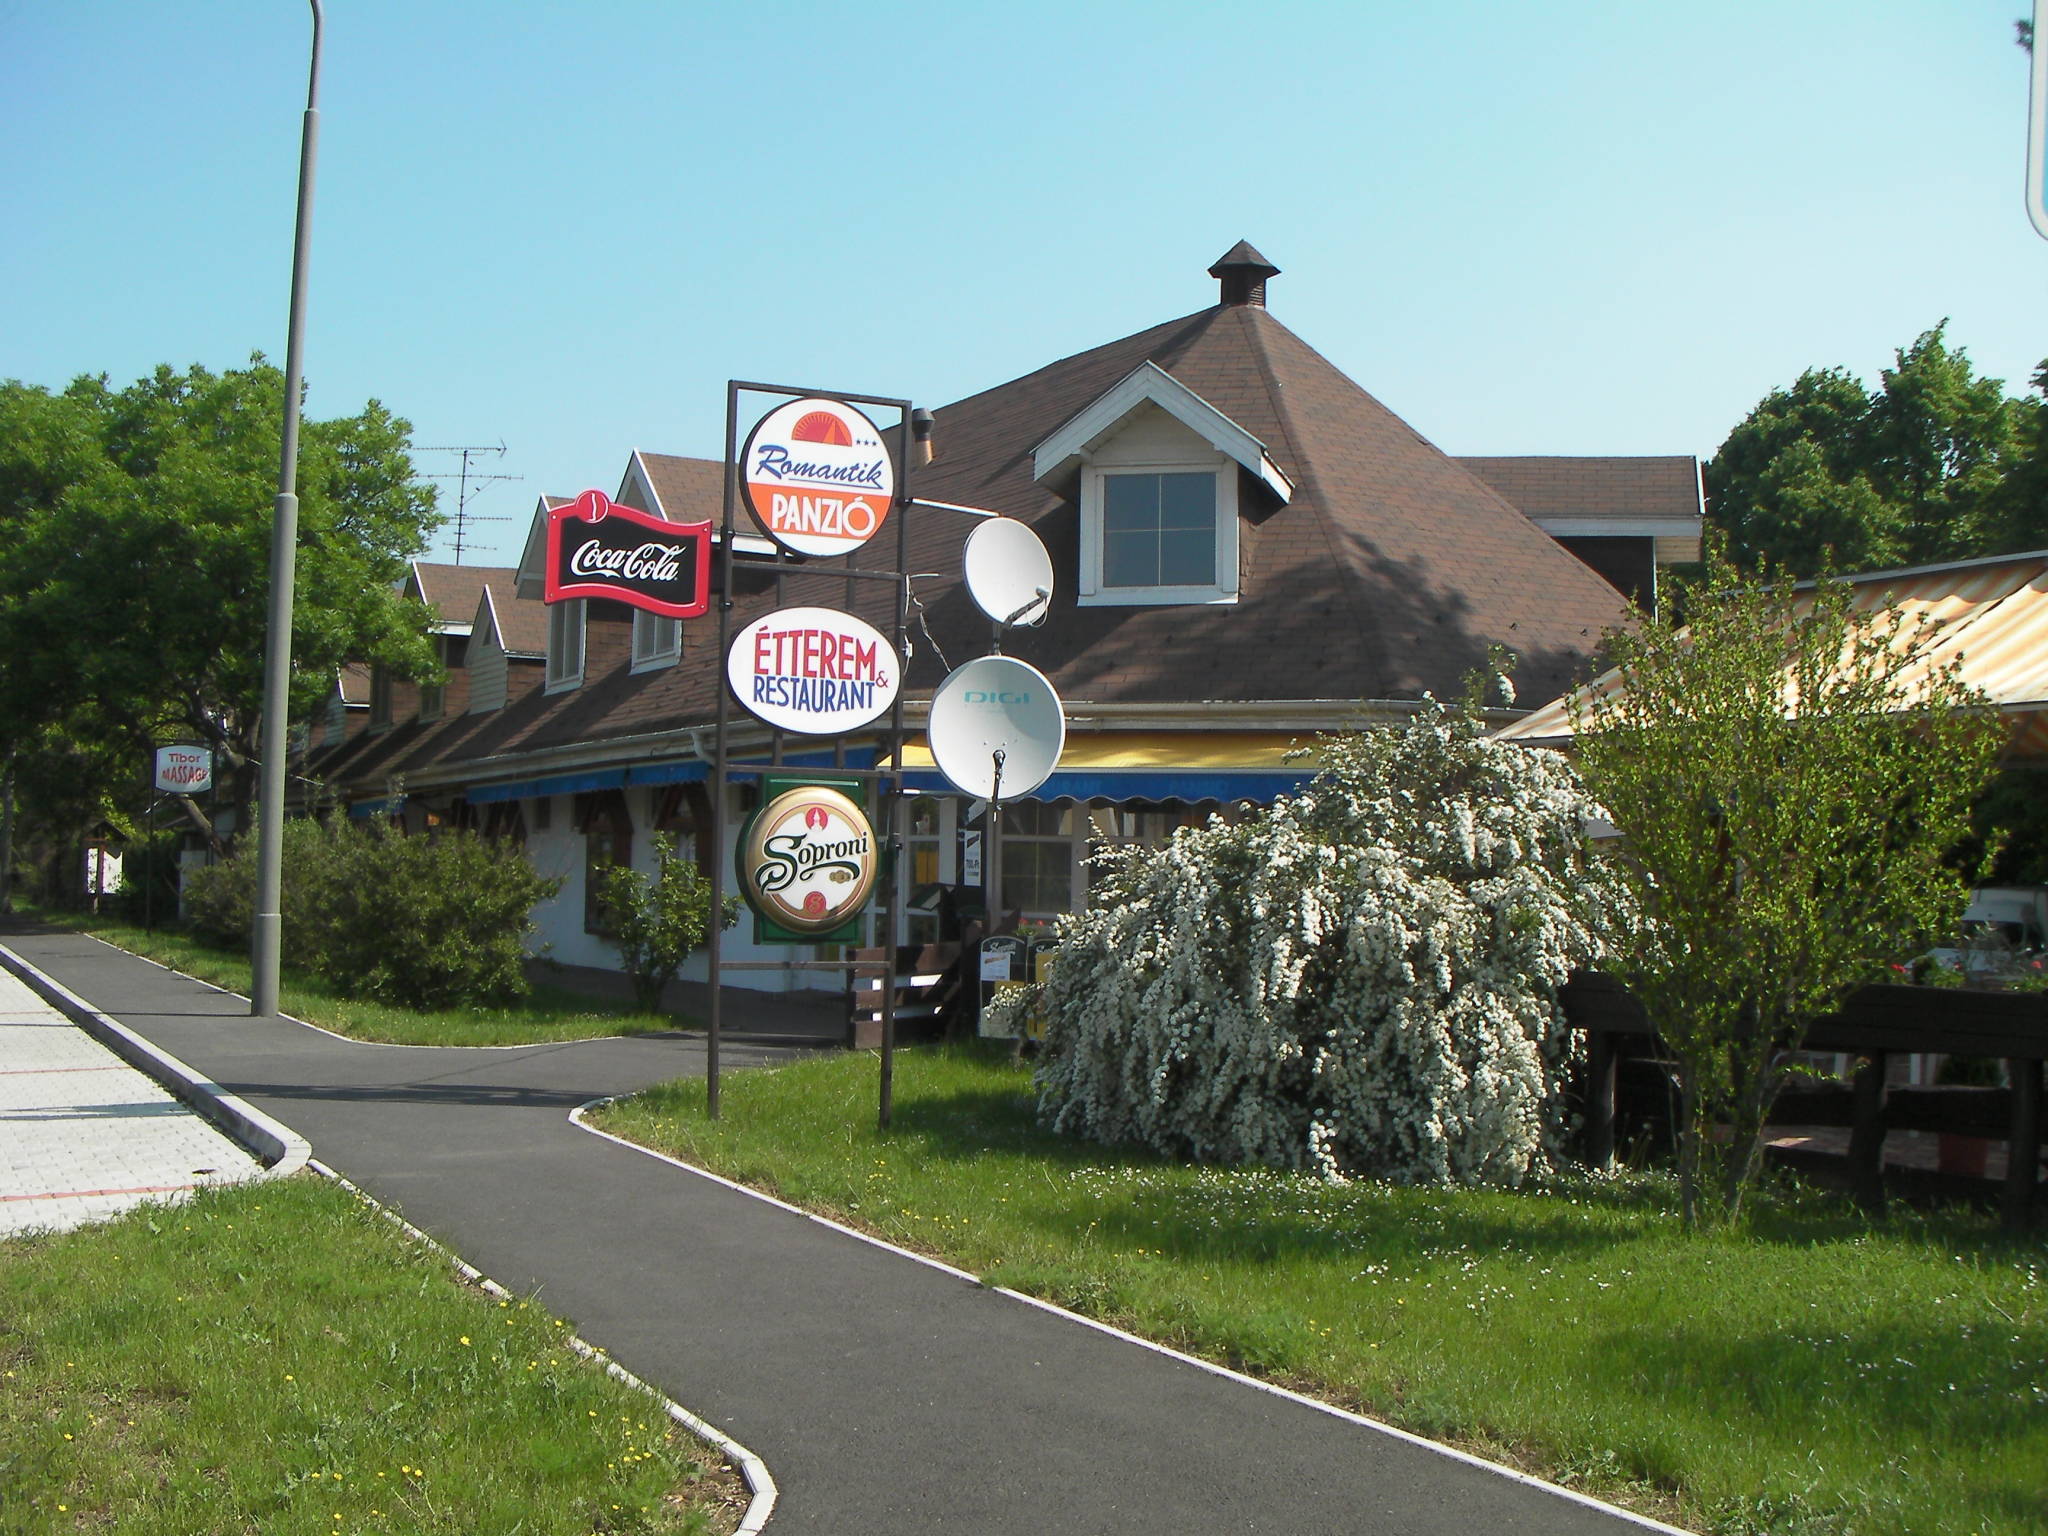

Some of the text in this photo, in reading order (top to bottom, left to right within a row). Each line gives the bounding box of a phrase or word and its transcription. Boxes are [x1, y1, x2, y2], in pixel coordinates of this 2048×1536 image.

[755, 444, 884, 490] Romantik
[771, 493, 876, 537] PANZIÓ
[570, 539, 688, 582] Coca-Cola
[754, 625, 889, 688] ÉTTEREM &
[753, 675, 875, 713] RESTAURANT
[964, 691, 1030, 704] DIGI
[162, 765, 208, 784] MASSAGE
[168, 752, 201, 763] Tibor
[755, 831, 869, 896] Soproni
